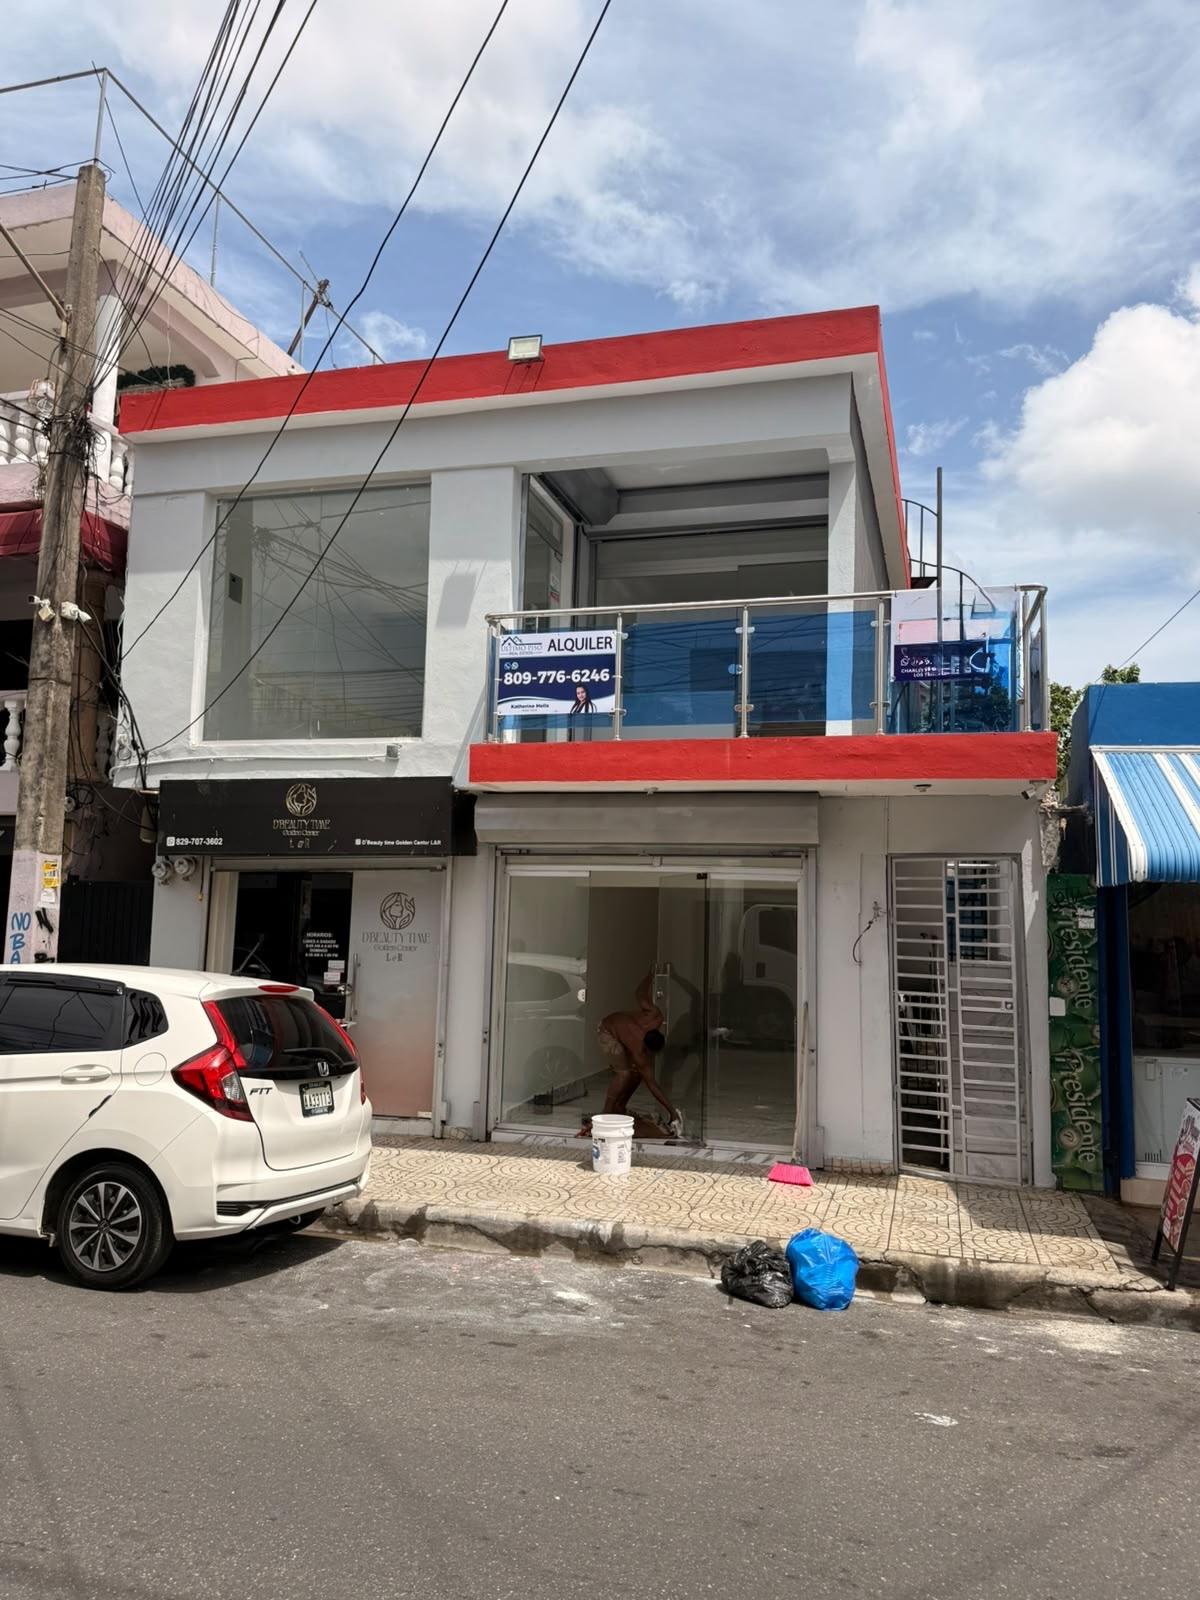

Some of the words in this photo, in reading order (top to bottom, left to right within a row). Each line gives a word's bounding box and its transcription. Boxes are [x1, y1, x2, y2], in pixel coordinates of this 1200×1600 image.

[547, 637, 613, 652] ALQUILER
[503, 669, 610, 685] 809-776-6246
[175, 837, 223, 846] 829-707-3602
[11, 911, 32, 932] NO
[249, 1087, 273, 1096] FIT
